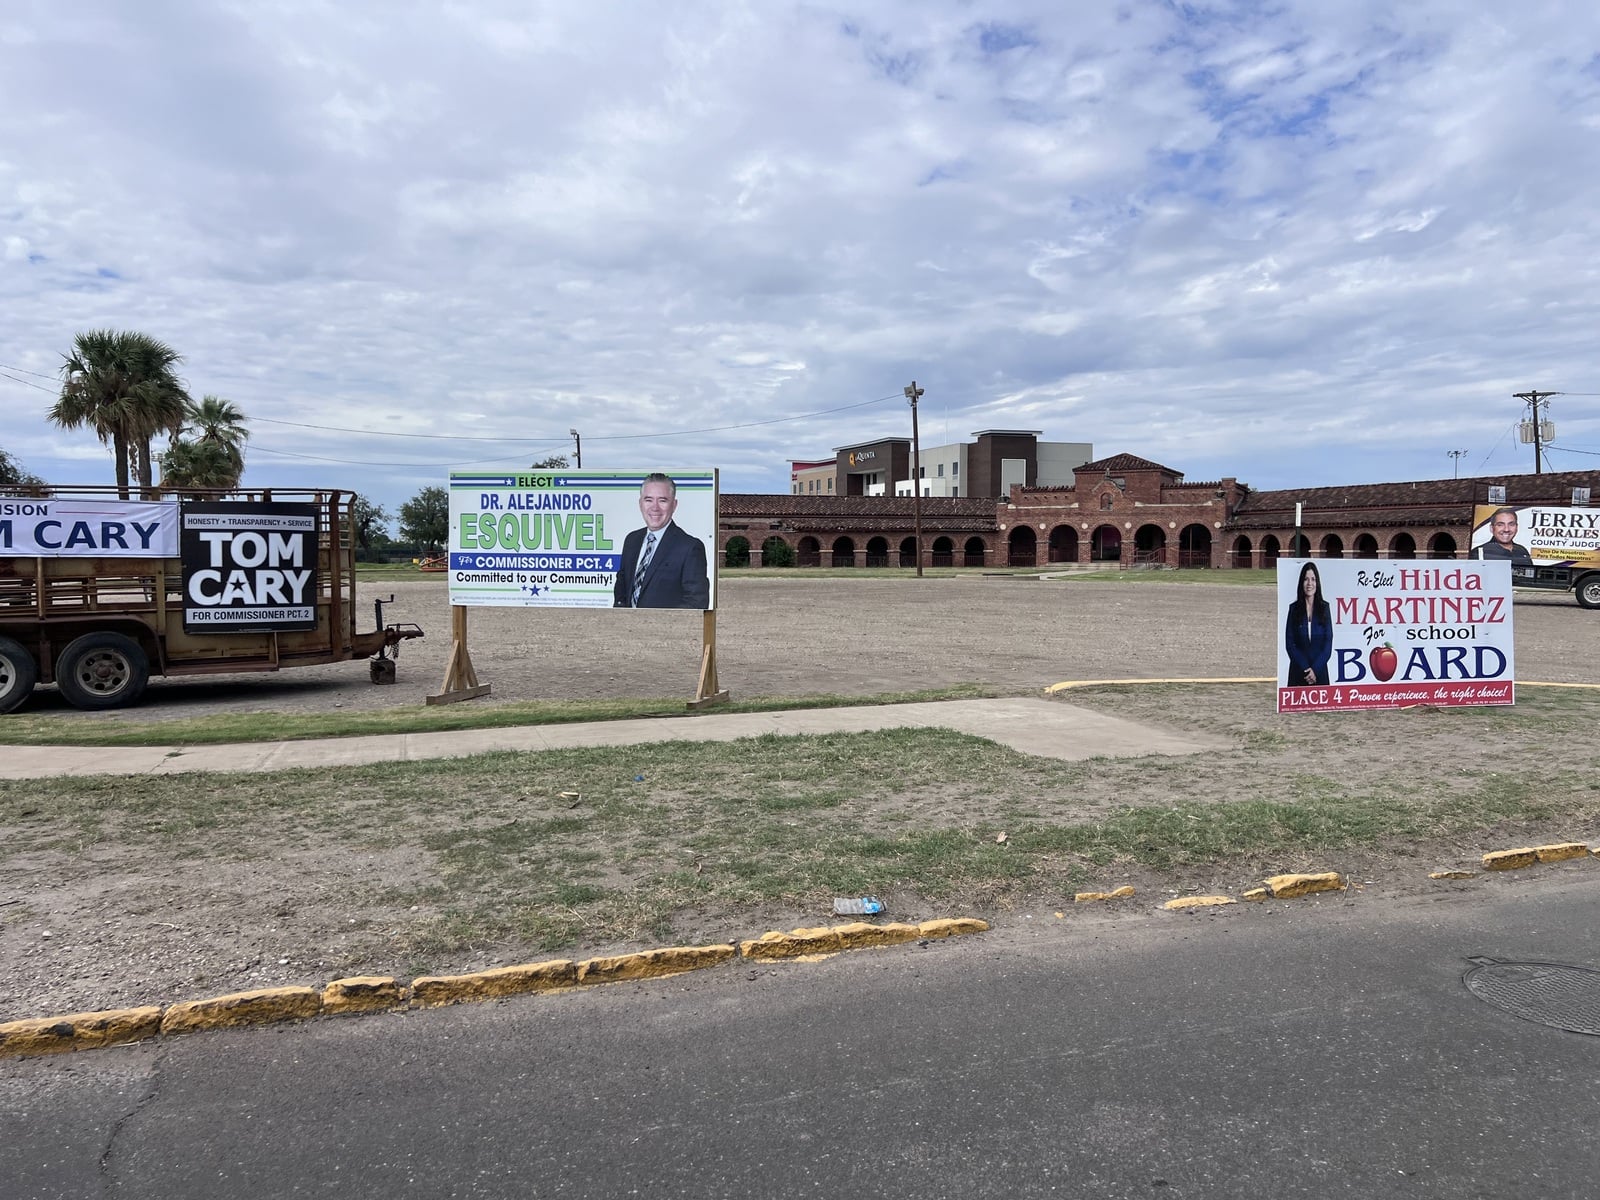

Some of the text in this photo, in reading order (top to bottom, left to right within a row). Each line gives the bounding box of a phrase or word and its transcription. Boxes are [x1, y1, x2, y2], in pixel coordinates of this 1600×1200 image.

[518, 477, 552, 487] ELECT
[480, 493, 592, 510] DR. ALEJANDRO
[228, 518, 281, 526] TRANSPARENCY
[1528, 513, 1600, 529] JERRY
[33, 520, 160, 549] CARY
[460, 512, 614, 553] ESQUIVEL
[1533, 528, 1599, 539] MORALES
[199, 531, 303, 568] TOM
[458, 556, 613, 569] For COMMISSIONER PCT. 4
[188, 569, 313, 606] CARY
[456, 572, 613, 586] Committed to our Community!
[1357, 569, 1482, 590] Re-Elect Hilda
[192, 610, 309, 621] FOR COMMISSIONER PCT. 2
[1336, 597, 1506, 624] MARTINEZ
[1363, 625, 1476, 646] For school
[1282, 690, 1328, 706] PLACE
[1333, 688, 1342, 703] 4
[1349, 689, 1381, 703] Proven
[1433, 686, 1448, 699] the
[1451, 686, 1475, 703] right
[1477, 685, 1508, 698] choice!
